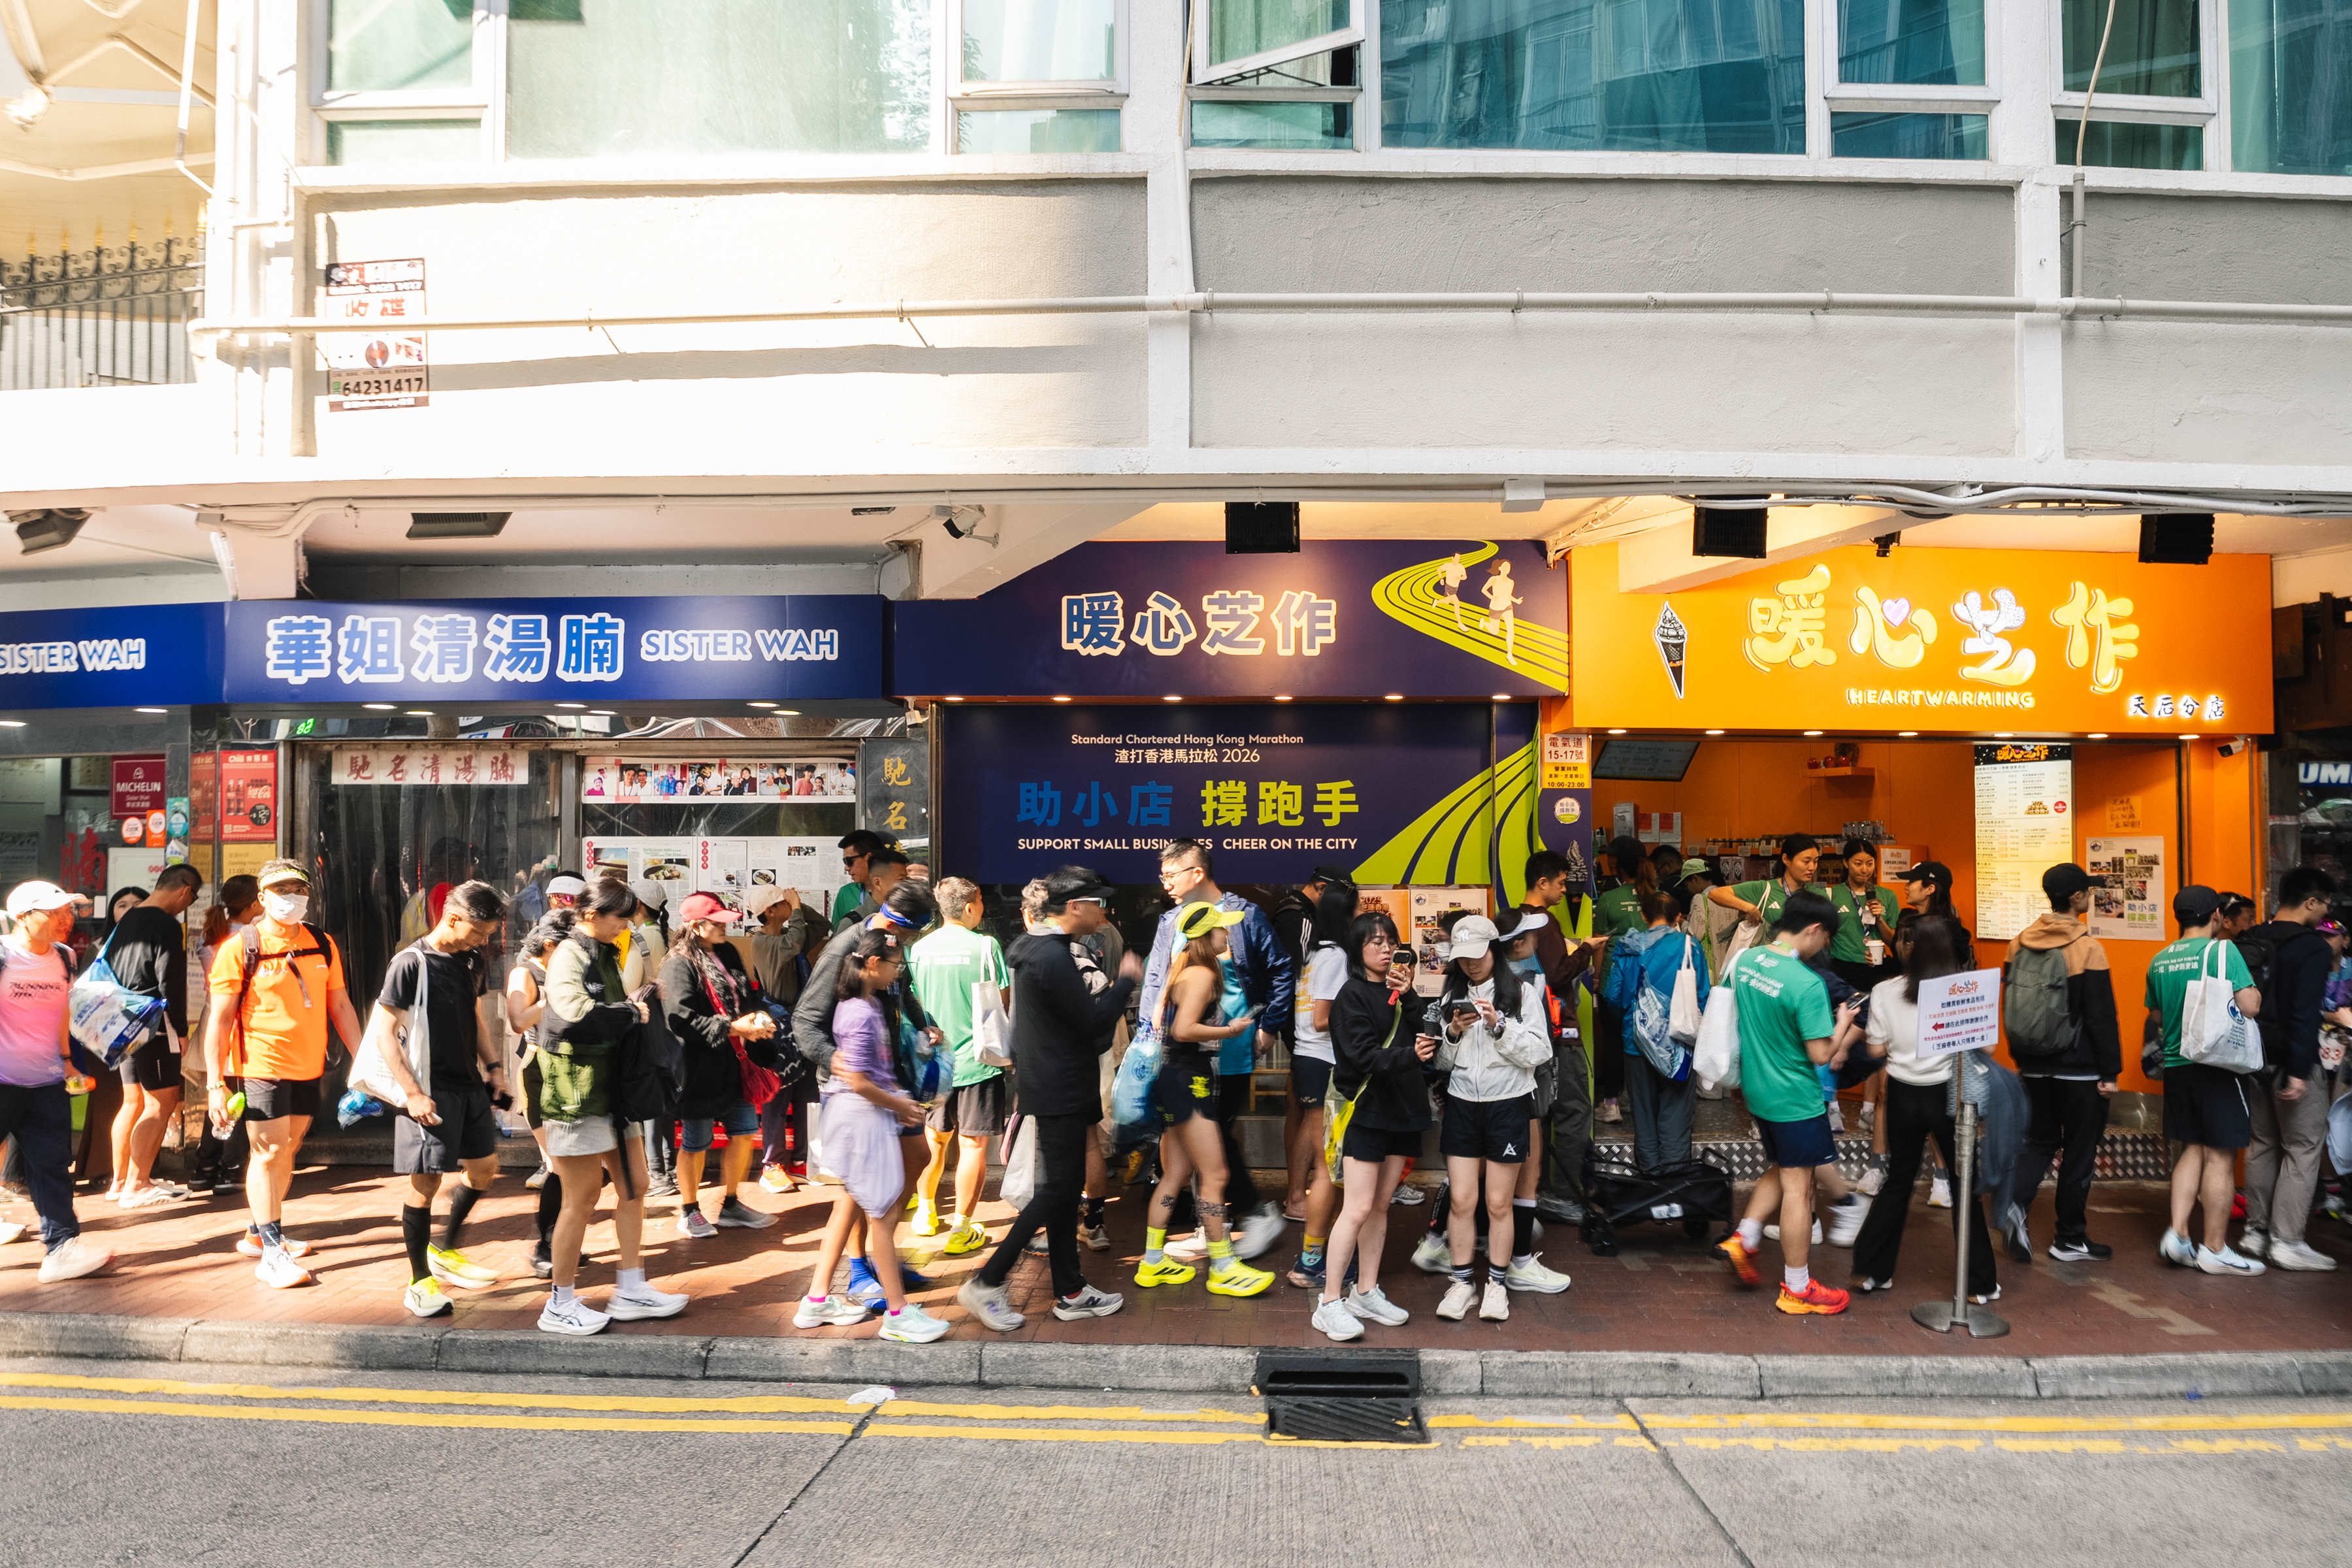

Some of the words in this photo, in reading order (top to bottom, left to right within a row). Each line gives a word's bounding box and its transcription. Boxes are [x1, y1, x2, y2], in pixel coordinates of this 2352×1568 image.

[342, 377, 423, 397] 64231417
[1062, 591, 1337, 656] 暖心芝作
[1743, 564, 2140, 694] 暖心芝作
[0, 642, 79, 674] SISTER
[78, 638, 146, 672] WAH
[266, 613, 625, 685] 華姐清湯腩
[640, 629, 752, 662] SISTER
[755, 629, 838, 661] WAH
[1847, 687, 2035, 710] HEARTWARMING
[2127, 694, 2225, 720] 天后分店
[1071, 734, 1122, 744] Standard
[1126, 734, 1181, 744] Chartered
[1184, 735, 1213, 746] Hong
[1217, 735, 1245, 746] Kong
[1249, 734, 1303, 744] Marathon
[1548, 737, 1584, 748] 電氣道
[1115, 749, 1218, 764] 渣打香港馬拉松
[1222, 749, 1260, 763] 2026
[1548, 750, 1584, 760] 15-17號
[347, 752, 515, 784] 馳名清湯腩
[2298, 762, 2352, 783] UM
[116, 782, 161, 792] MICHELIN
[1017, 781, 1173, 826] 助小店
[1201, 780, 1359, 826] 撐跑手
[1018, 838, 1081, 849] SUPPORT
[1084, 838, 1130, 849] SMALL
[1133, 838, 1213, 849] BUSINES
[1222, 838, 1266, 849] CHEER
[1270, 838, 1290, 849] ON
[1296, 838, 1323, 849] THE
[1328, 838, 1358, 849] CITY
